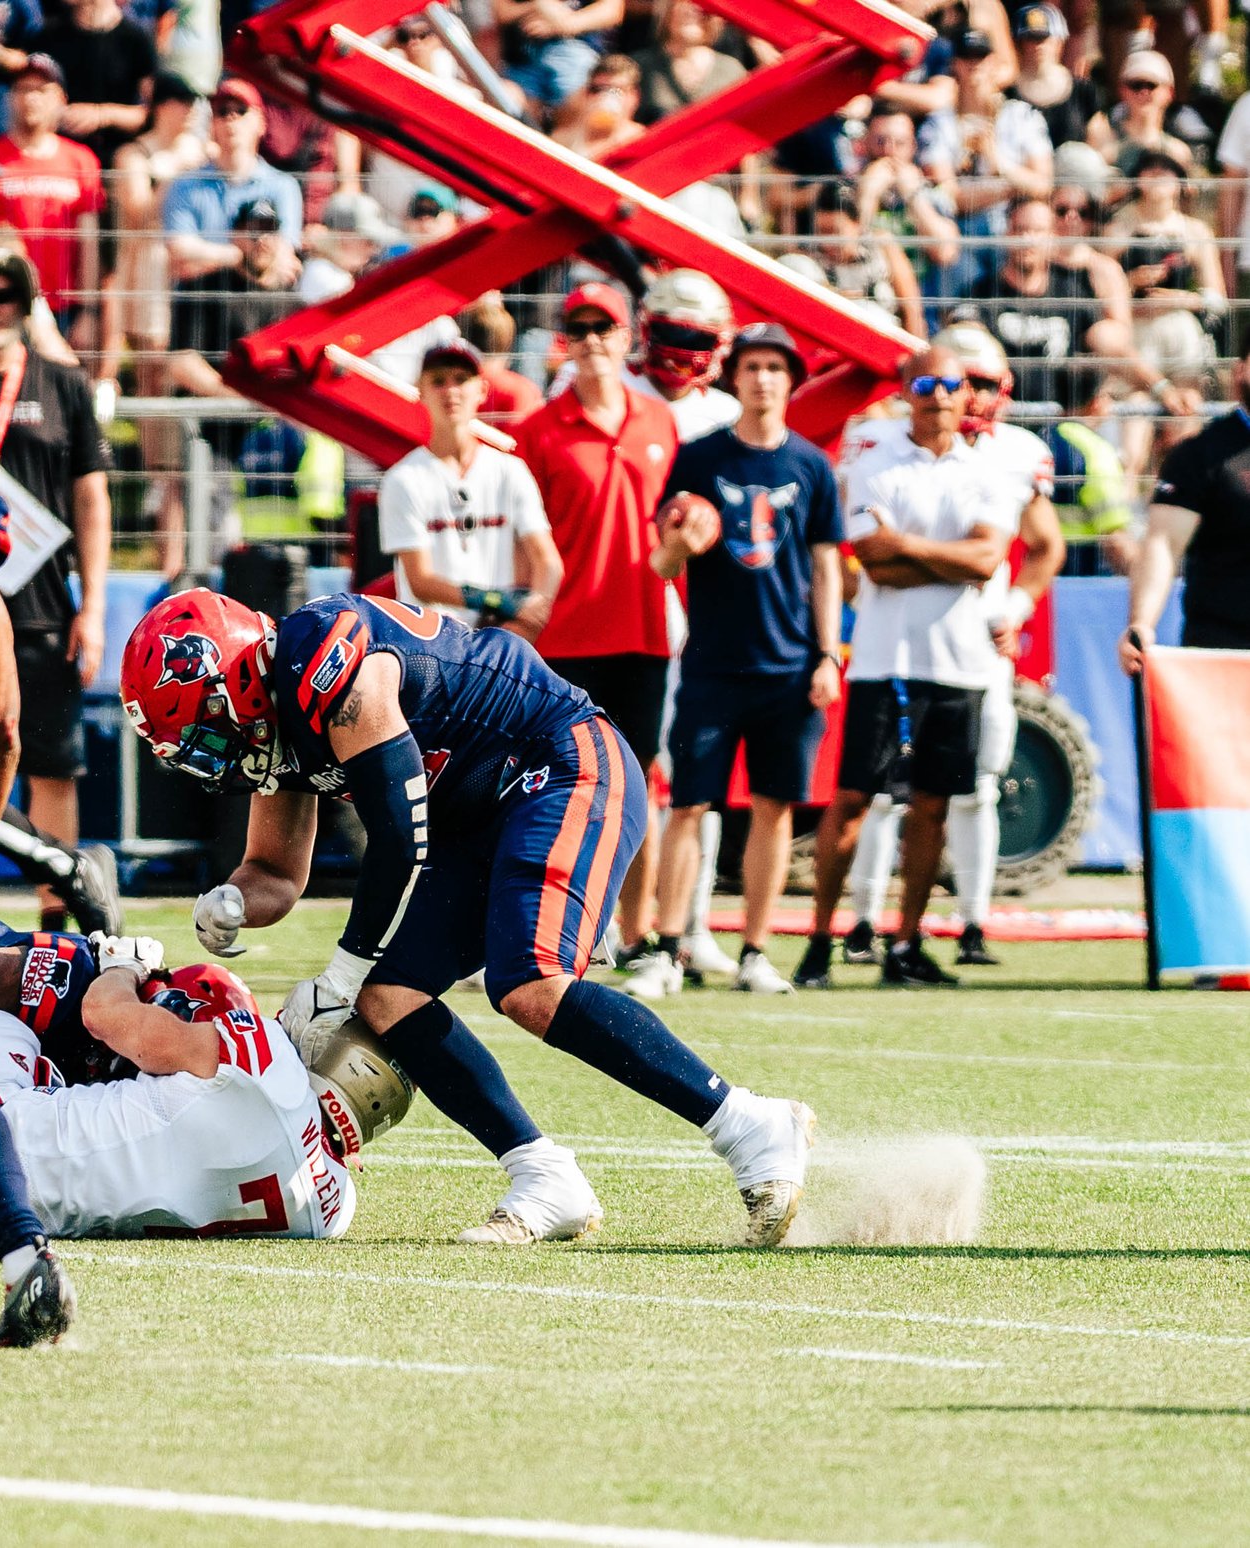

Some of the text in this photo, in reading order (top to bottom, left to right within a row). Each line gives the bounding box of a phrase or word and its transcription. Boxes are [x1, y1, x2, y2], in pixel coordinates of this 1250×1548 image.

[21, 950, 43, 1002] HOUSE
[29, 950, 55, 1002] BLOCK
[302, 1117, 341, 1228] WILZECK
